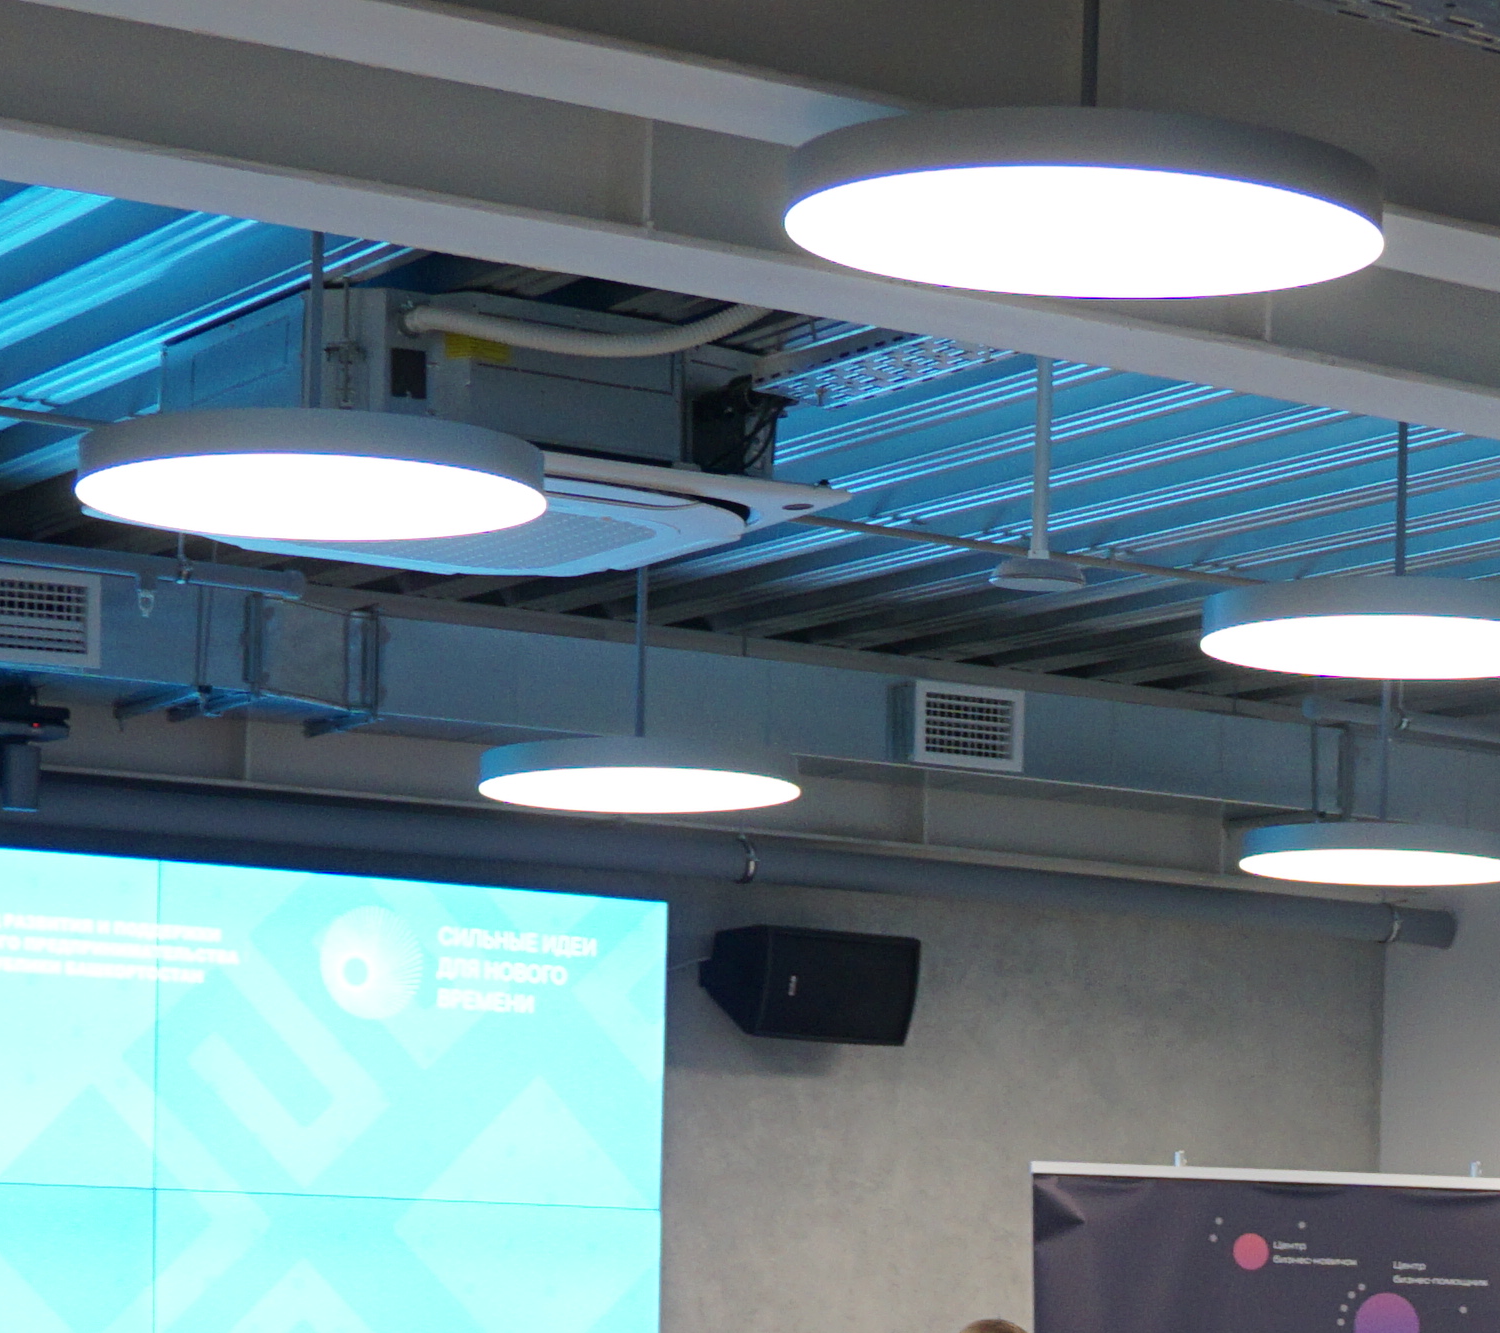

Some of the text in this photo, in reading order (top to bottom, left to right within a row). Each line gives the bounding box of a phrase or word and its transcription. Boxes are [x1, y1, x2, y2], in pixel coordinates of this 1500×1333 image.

[437, 925, 598, 959] СИЛЬНЫЕ ИДЕИ
[436, 956, 569, 986] ДЛЯ НОВОГО
[437, 987, 535, 1014] ВРЕМЕНИ
